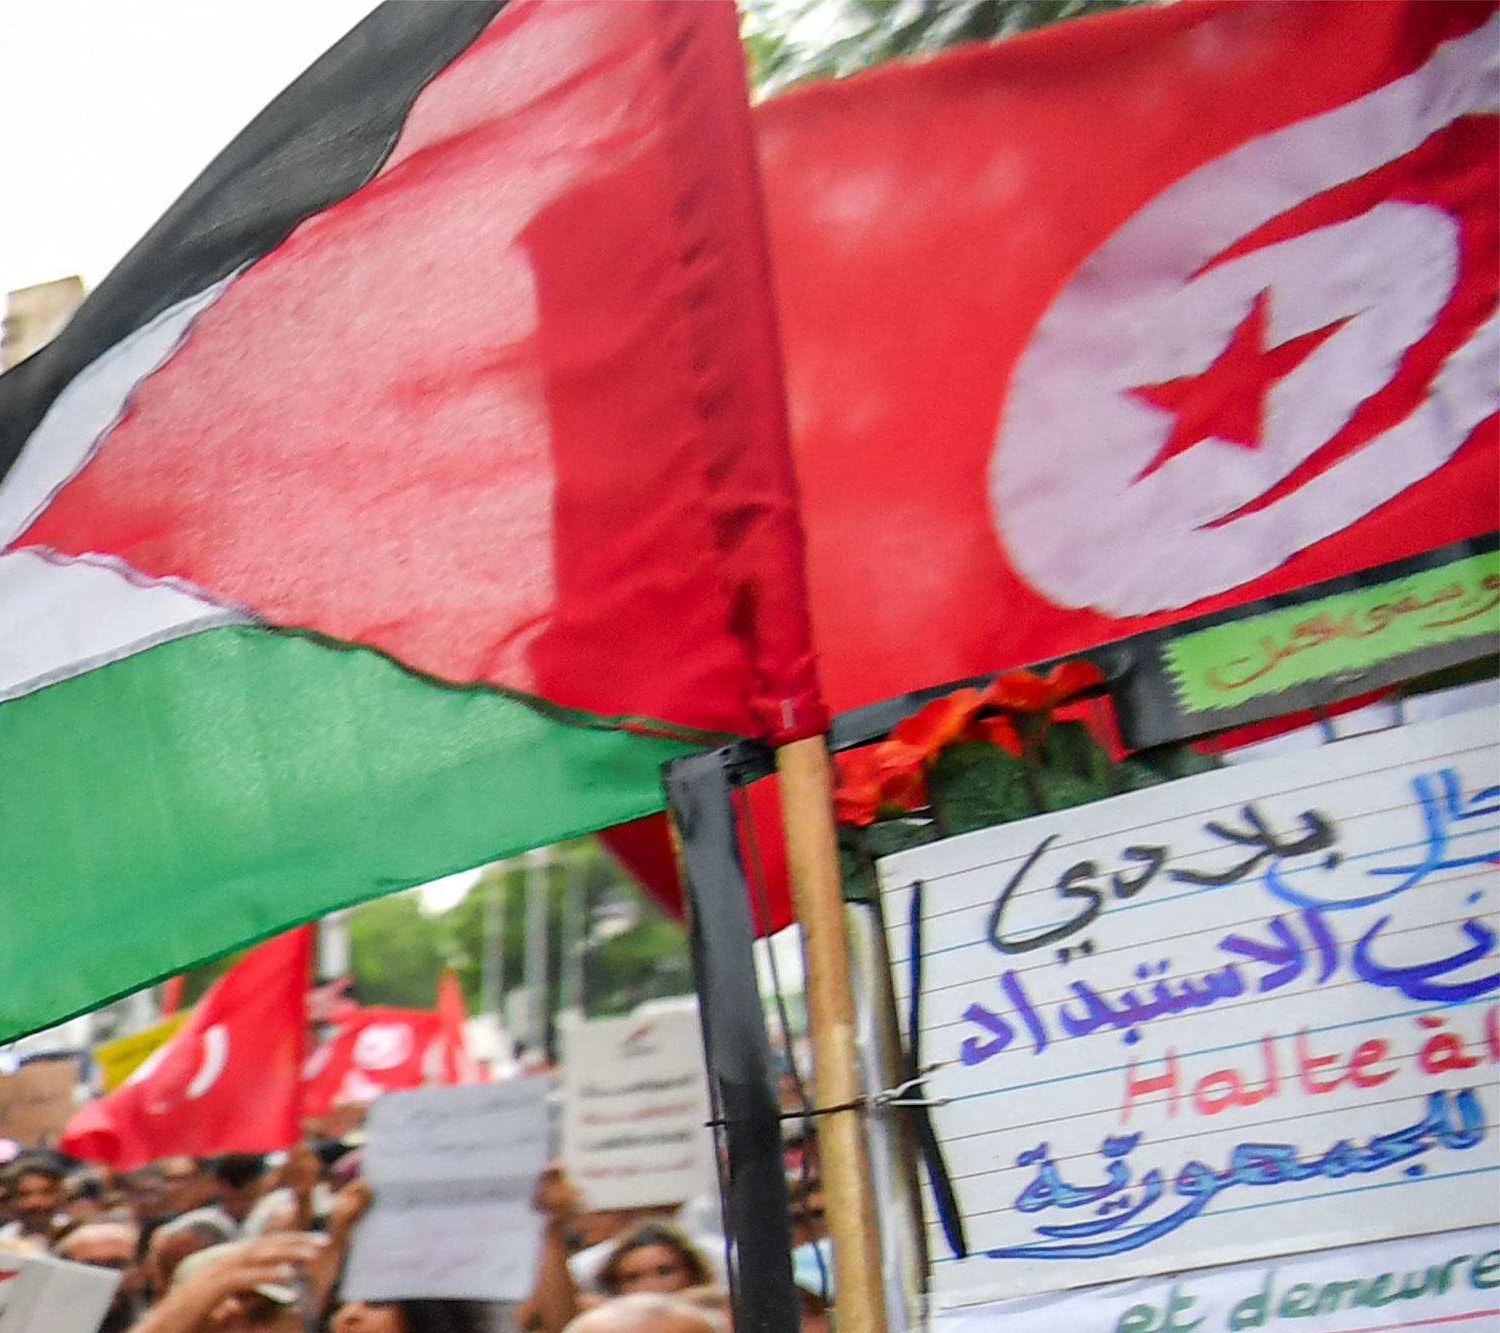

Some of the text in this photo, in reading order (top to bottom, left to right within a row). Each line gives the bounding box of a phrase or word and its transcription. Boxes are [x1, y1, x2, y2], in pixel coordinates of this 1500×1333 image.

[988, 804, 1344, 964] بلادي
[959, 907, 1341, 1067] الاستبداد
[1119, 1027, 1401, 1125] Halte
